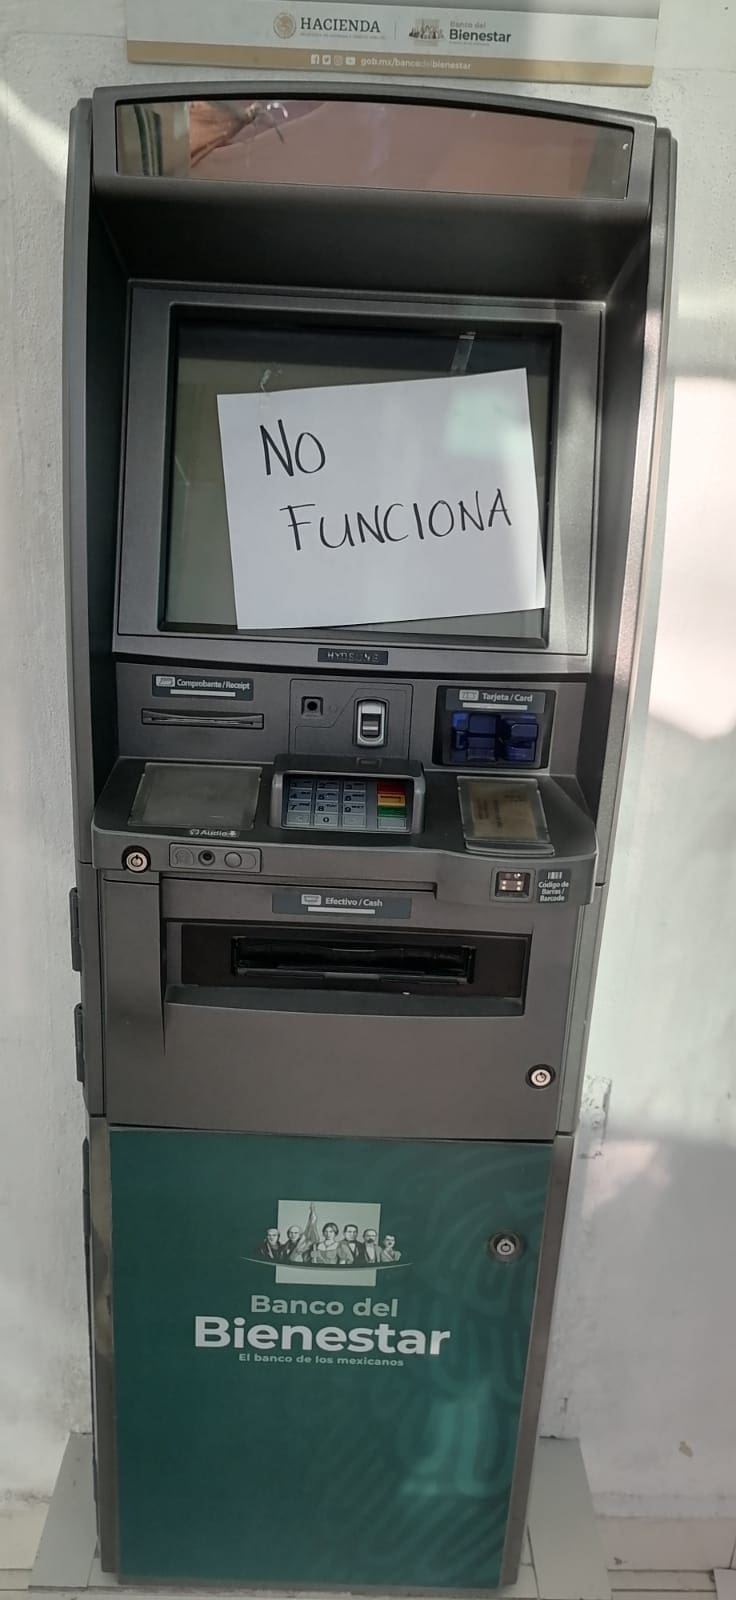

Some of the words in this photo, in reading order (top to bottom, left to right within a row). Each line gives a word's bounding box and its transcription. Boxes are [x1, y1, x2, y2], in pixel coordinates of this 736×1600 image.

[300, 17, 381, 33] HACIENDA
[449, 29, 512, 43] Bienestar
[259, 419, 326, 477] NO
[280, 488, 512, 551] FUNCIONA
[176, 678, 221, 690] Comprobante
[226, 680, 251, 691] Receipt
[482, 692, 509, 702] Tarjeta
[514, 693, 533, 702] Card
[538, 881, 560, 889] Código
[325, 897, 358, 906] Efectivo
[363, 898, 383, 907] Cash
[251, 1294, 344, 1315] Banco
[352, 1298, 399, 1317] del
[194, 1315, 451, 1355] Bienestar
[238, 1353, 250, 1361] El
[254, 1354, 293, 1363] banco
[296, 1354, 312, 1364] de
[315, 1355, 334, 1364] los
[337, 1357, 404, 1366] mexicanos
